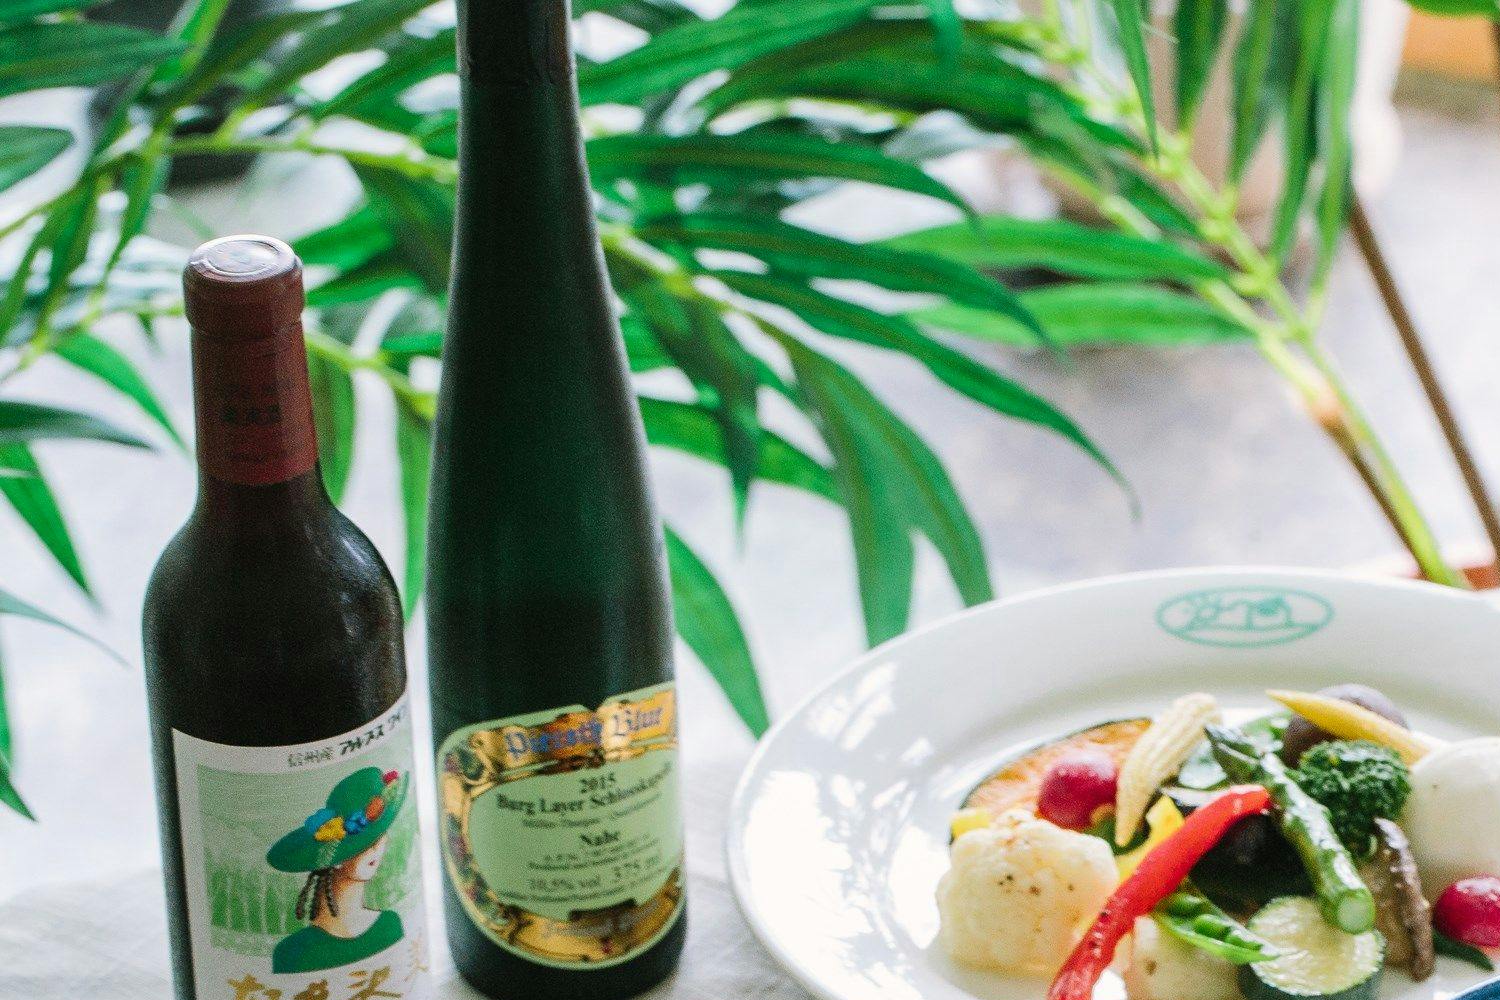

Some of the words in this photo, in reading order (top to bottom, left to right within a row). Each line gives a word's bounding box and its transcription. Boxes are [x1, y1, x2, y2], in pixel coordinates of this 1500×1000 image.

[579, 772, 616, 795] 2015
[495, 793, 535, 816] Burg
[538, 797, 585, 818] Layer
[579, 829, 621, 848] Nahe
